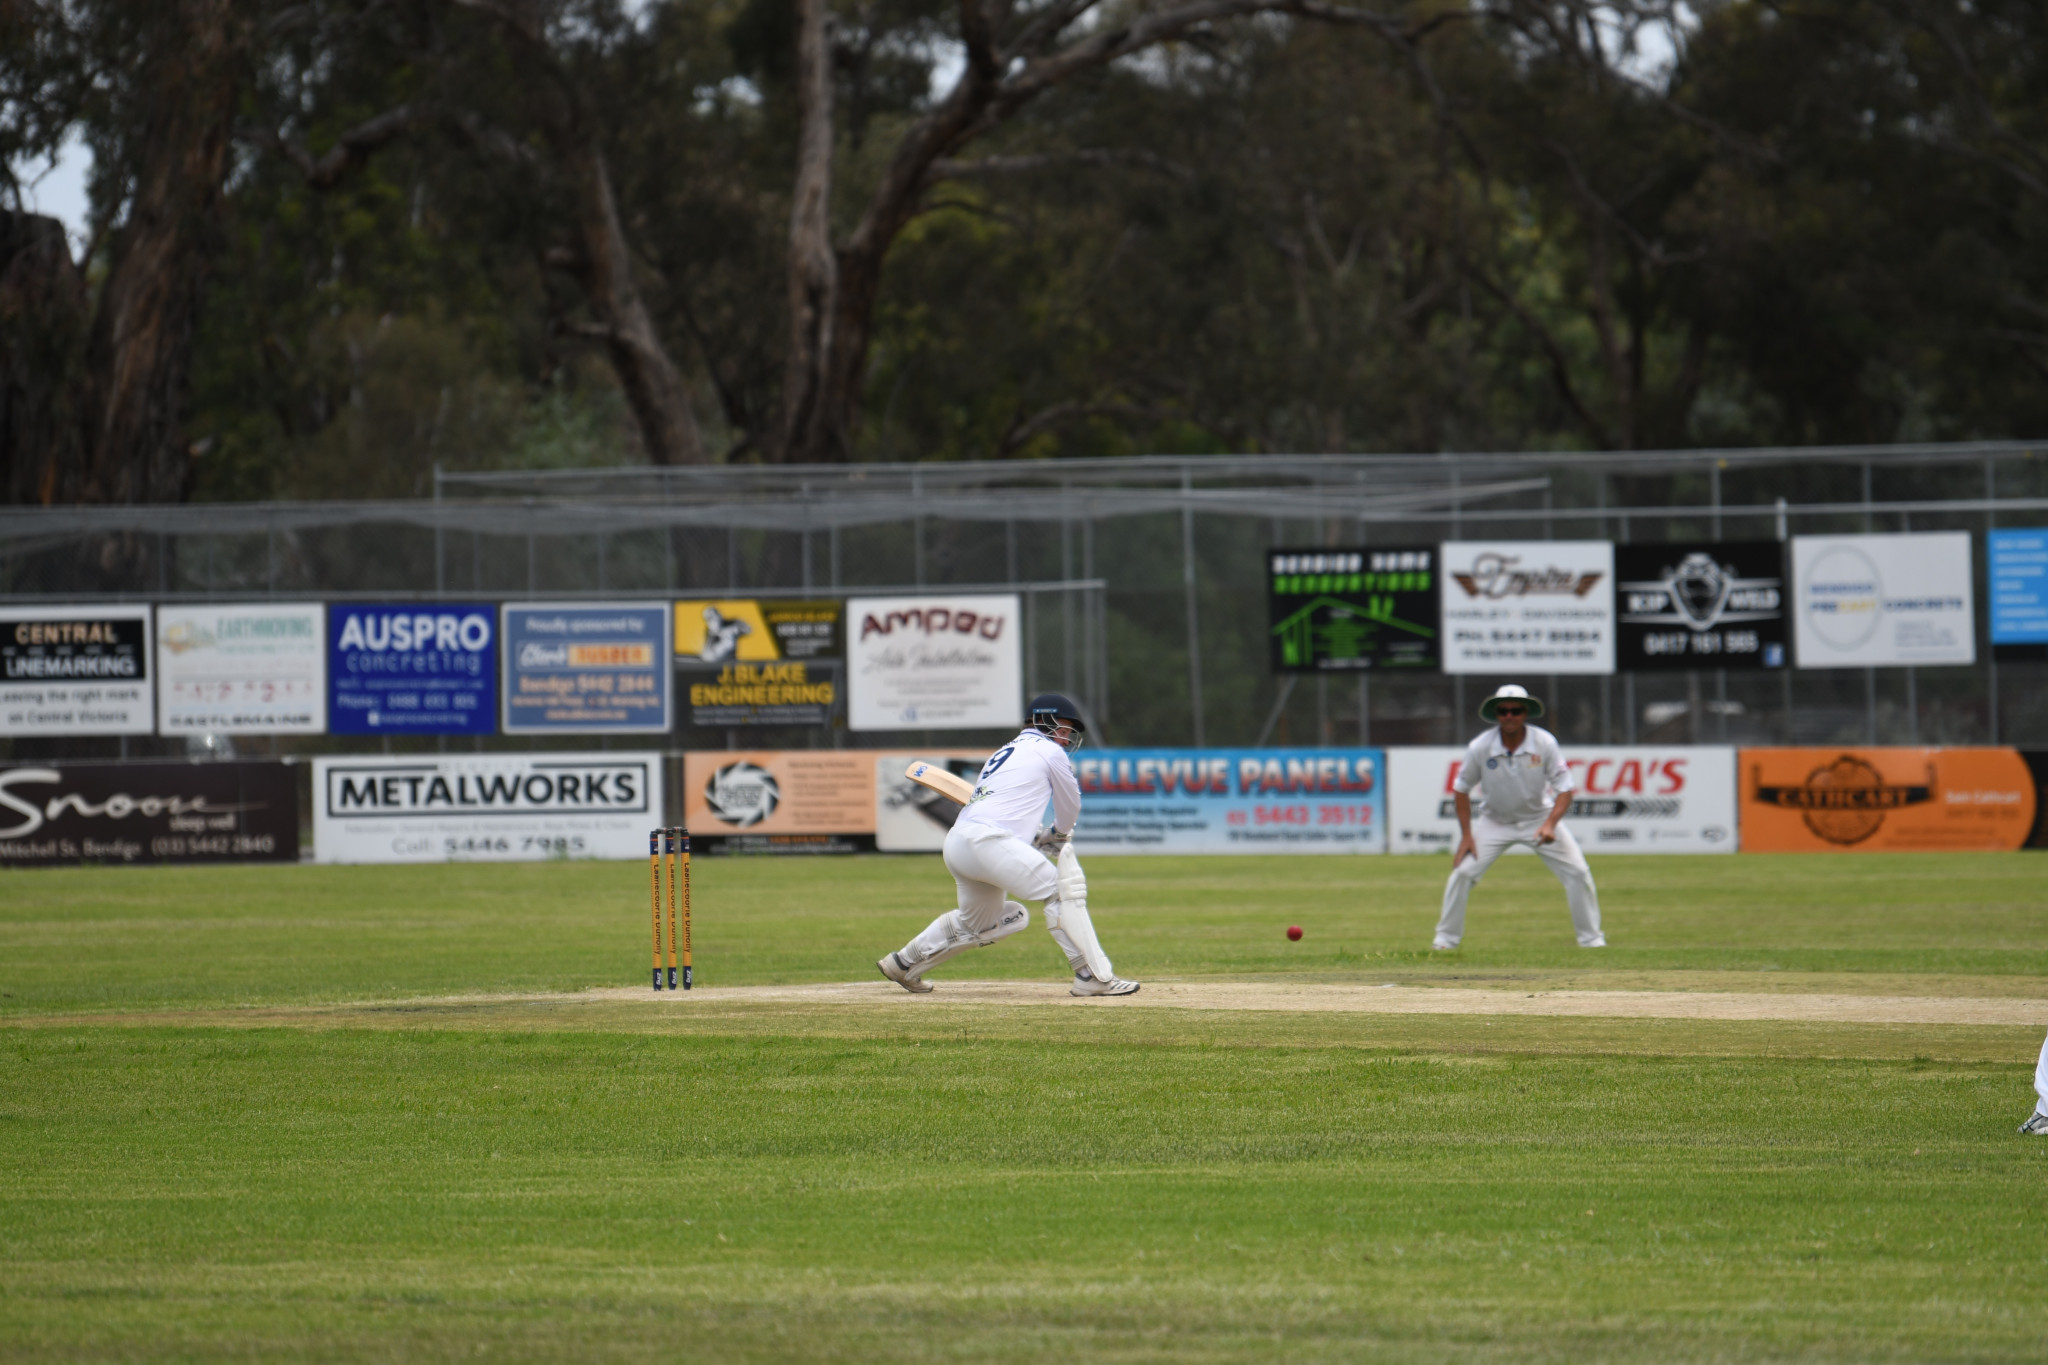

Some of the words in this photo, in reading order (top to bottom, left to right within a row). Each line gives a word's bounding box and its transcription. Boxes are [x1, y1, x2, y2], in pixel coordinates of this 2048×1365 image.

[15, 622, 117, 645] CENTRAL
[339, 614, 490, 651] AUSPRO
[6, 655, 136, 677] LINEMARKING
[346, 652, 481, 675] concreting
[690, 683, 834, 706] ENGINEERING
[982, 746, 1015, 780] 9
[1239, 757, 1375, 794] PANELS
[339, 772, 636, 807] METALWORKS
[653, 863, 661, 920] Laanecoorie
[653, 922, 661, 955] Dunolly
